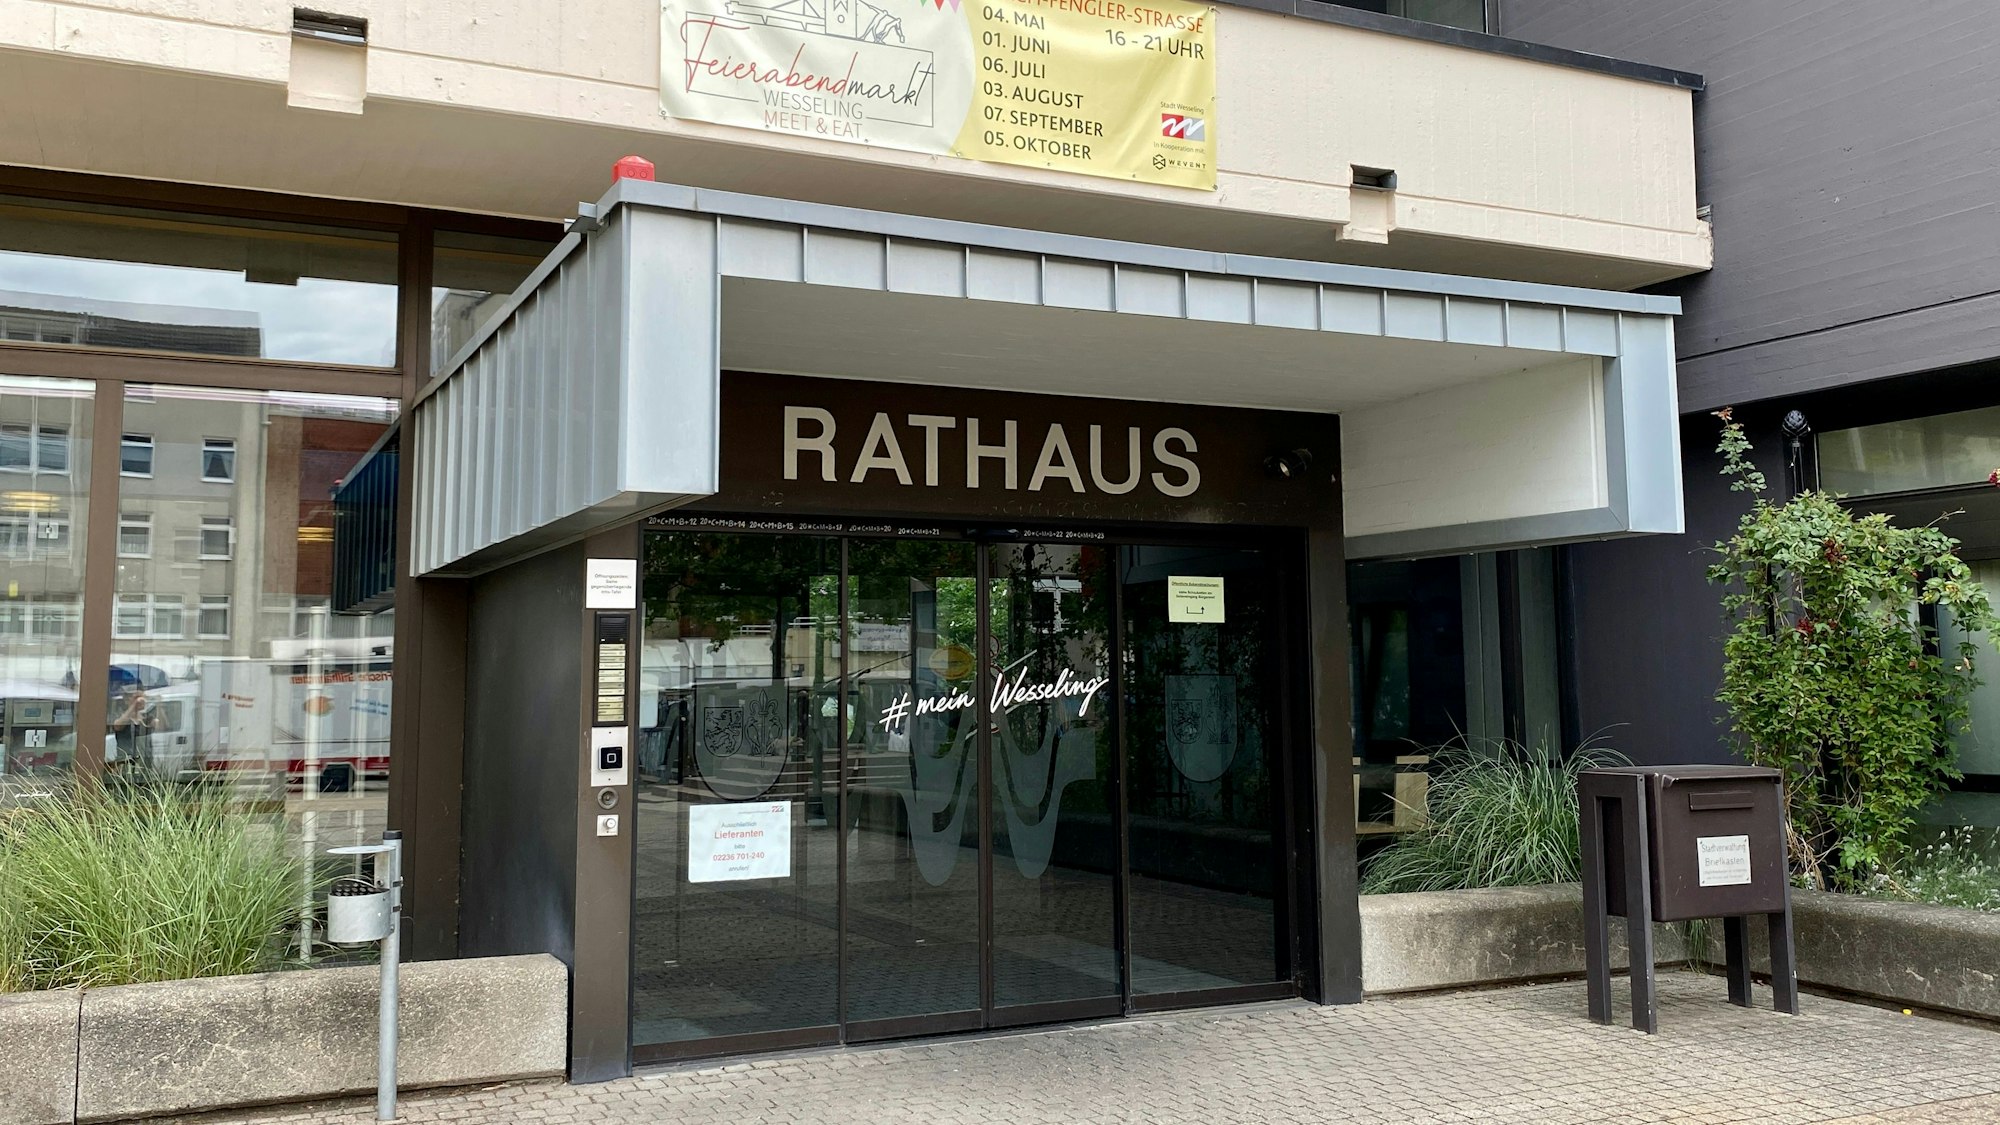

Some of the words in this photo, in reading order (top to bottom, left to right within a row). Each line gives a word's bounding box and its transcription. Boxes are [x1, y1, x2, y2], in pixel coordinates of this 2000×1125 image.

[983, 5, 1009, 24] 04.
[1014, 11, 1045, 30] MAI
[982, 31, 1006, 48] 01.
[1011, 35, 1050, 55] JUNI
[1105, 29, 1126, 47] 16
[1143, 34, 1163, 52] 21
[1168, 37, 1205, 60] UHR
[680, 16, 936, 106] Feierabendmarkt
[982, 56, 1008, 74] 06.
[1012, 60, 1045, 79] JULI
[763, 89, 863, 120] WESSELING
[983, 81, 1008, 99] 03.
[1012, 85, 1084, 109] AUGUST
[1160, 101, 1176, 109] Stadt
[1177, 103, 1205, 115] Wesseling
[764, 110, 810, 131] MEET
[816, 117, 828, 134] &
[833, 120, 863, 138] EAT
[984, 105, 1006, 123] 07.
[1010, 110, 1104, 137] SEPTEMBER
[984, 130, 1009, 148] 05.
[1013, 135, 1092, 160] OKTOBER
[1160, 142, 1194, 153] Kooperation
[1168, 159, 1206, 169] WEVENT
[783, 405, 1200, 498] RATHAUS
[990, 666, 1109, 717] Wesseling
[714, 830, 764, 839] Lieferanten
[736, 852, 765, 860] 701-240
[1704, 857, 1745, 867] Briefkasten
